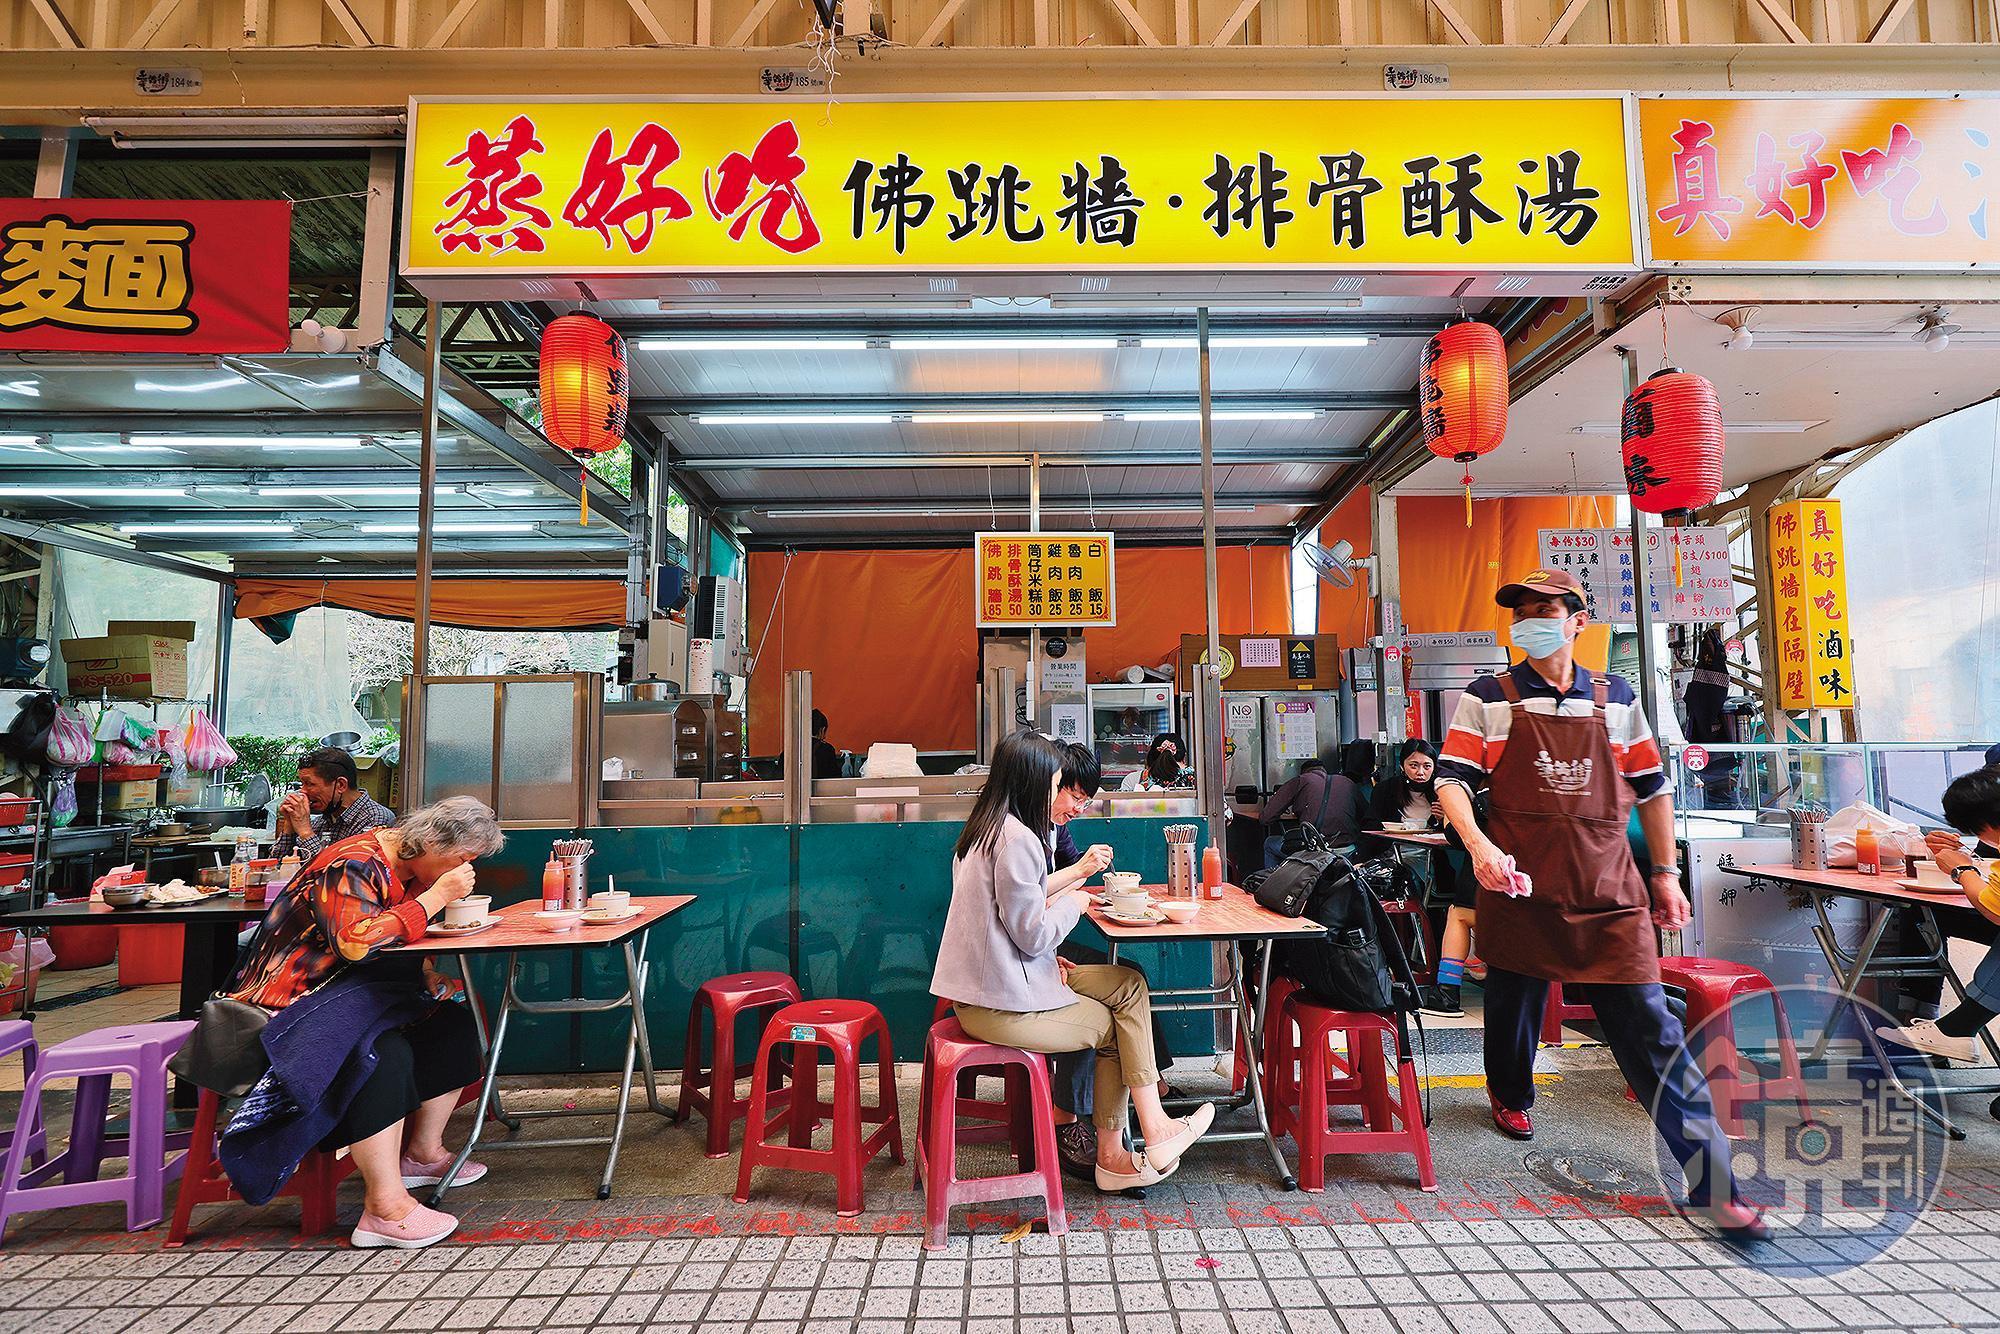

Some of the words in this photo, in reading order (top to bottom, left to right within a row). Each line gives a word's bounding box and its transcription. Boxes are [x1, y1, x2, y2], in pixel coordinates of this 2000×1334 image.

[171, 77, 185, 87] 184
[796, 77, 809, 86] 185
[1419, 73, 1433, 83] 186
[434, 114, 823, 256] 蒸好吃
[1657, 119, 1992, 241] 真好吃
[0, 215, 197, 334] 麵
[987, 543, 1002, 603] 佛跳牆
[1007, 543, 1022, 603] 排骨酥湯
[1027, 543, 1043, 603] 筒仔米糕
[1047, 543, 1063, 603] 雞肉飯
[1068, 543, 1083, 603] 魯肉飯
[988, 604, 1001, 616] 85
[1009, 604, 1022, 616] 50
[1029, 604, 1042, 616] 30
[1049, 604, 1062, 616] 25
[1069, 604, 1082, 616] 25
[1089, 604, 1103, 616] 15
[1691, 607, 1732, 617] 3支/$10
[1775, 511, 1806, 700] 佛跳牆在隔壁
[80, 672, 133, 688] YS-520
